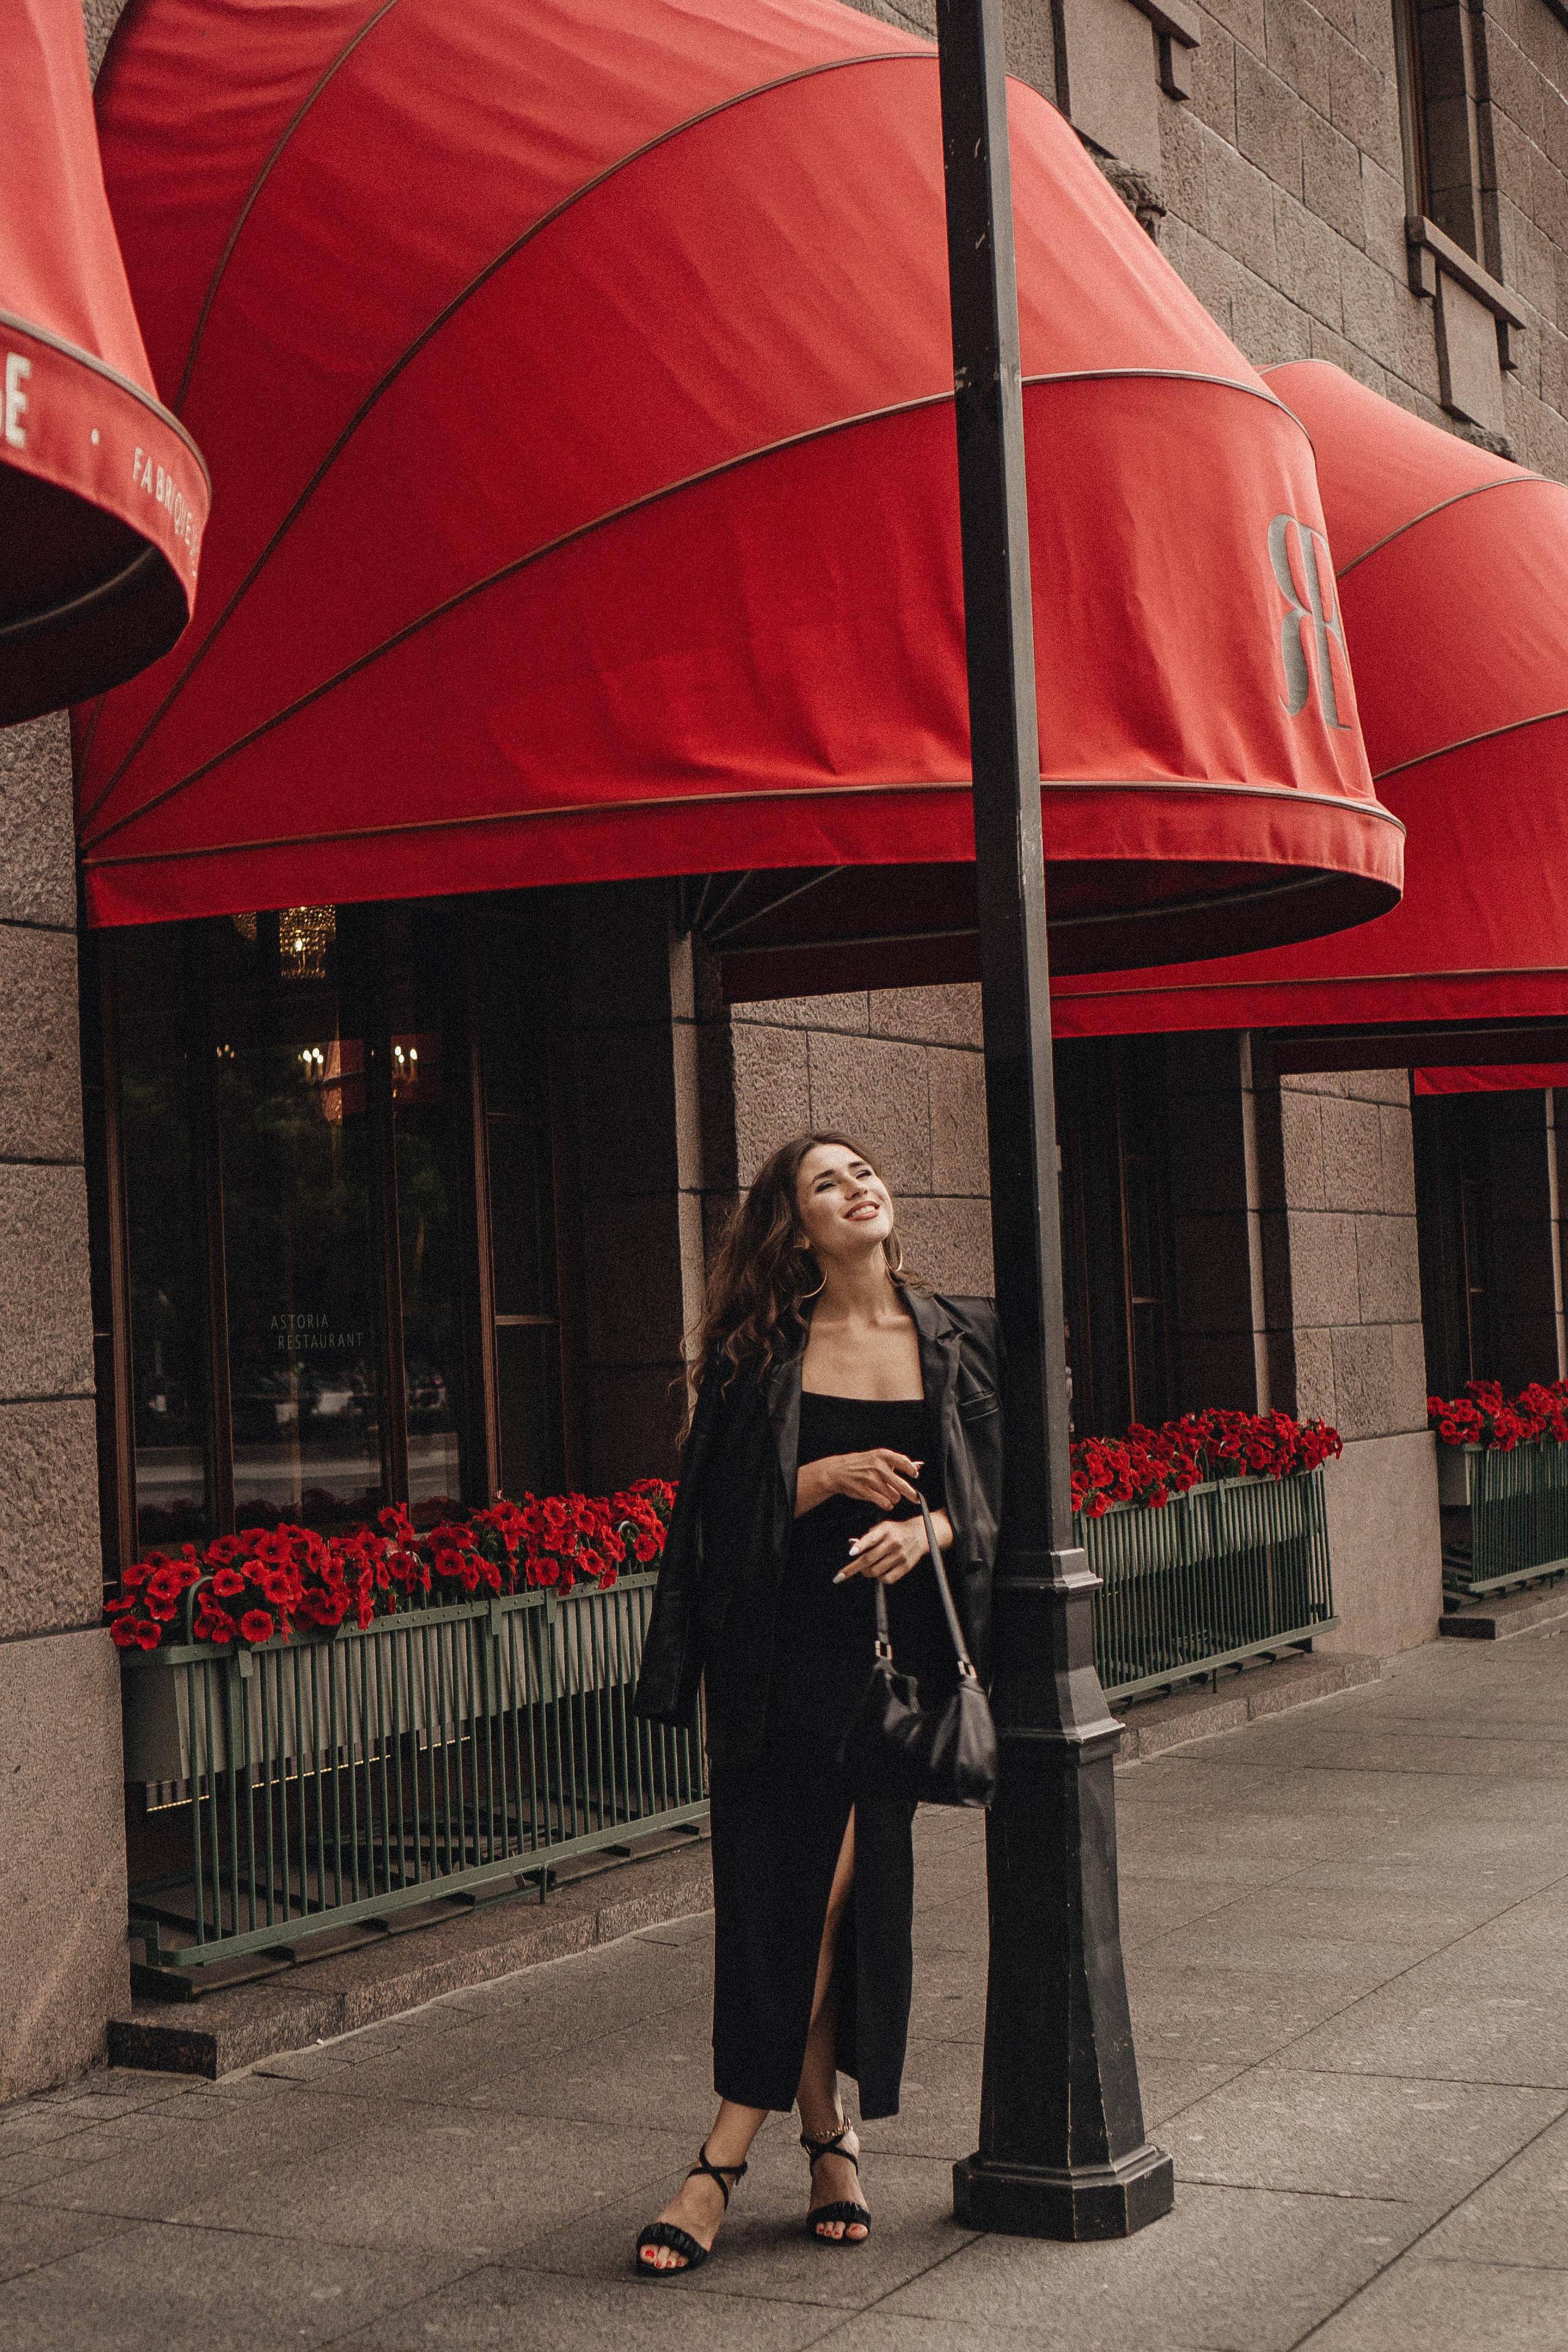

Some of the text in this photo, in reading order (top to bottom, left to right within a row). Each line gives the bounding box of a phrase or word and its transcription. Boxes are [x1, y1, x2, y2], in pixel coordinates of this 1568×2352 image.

[0, 352, 31, 448] E
[271, 1314, 328, 1330] ASTORIA
[279, 1332, 363, 1349] RESTAURANT
